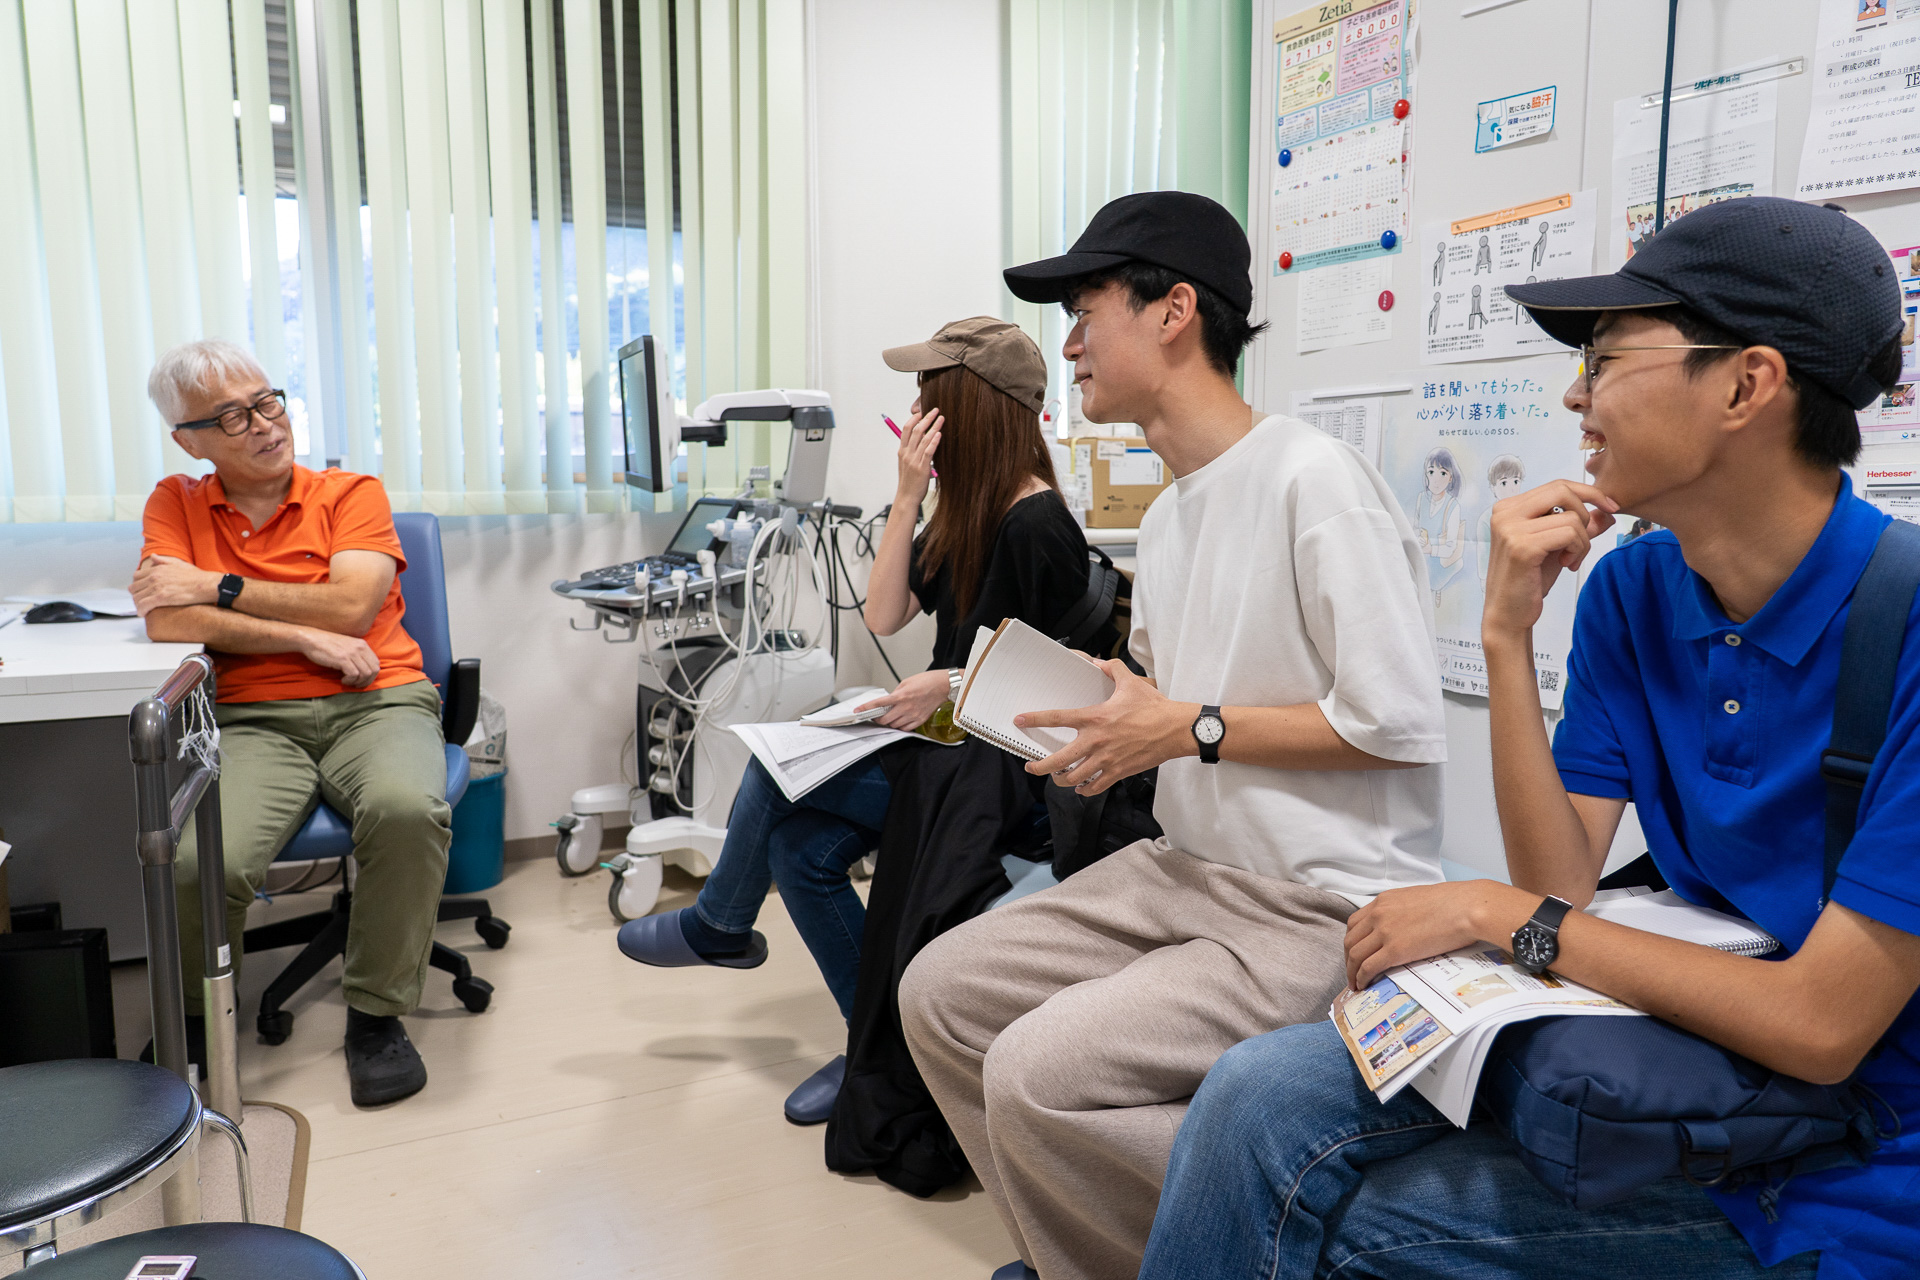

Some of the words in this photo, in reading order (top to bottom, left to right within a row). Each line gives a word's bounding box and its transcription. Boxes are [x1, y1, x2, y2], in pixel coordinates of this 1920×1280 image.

[1319, 1, 1352, 23] Zetia
[1346, 2, 1400, 28] 子ども医療電話相談
[1286, 27, 1334, 52] 救急医療電話相談
[1345, 14, 1398, 43] #8000
[1285, 40, 1332, 67] #7119
[1842, 58, 1880, 73] 作成の流れ
[1509, 93, 1552, 113] 気になる脇汗
[1422, 378, 1543, 399] 話を聞いてもらった。
[1416, 402, 1549, 421] 心が少し落ち着いた。
